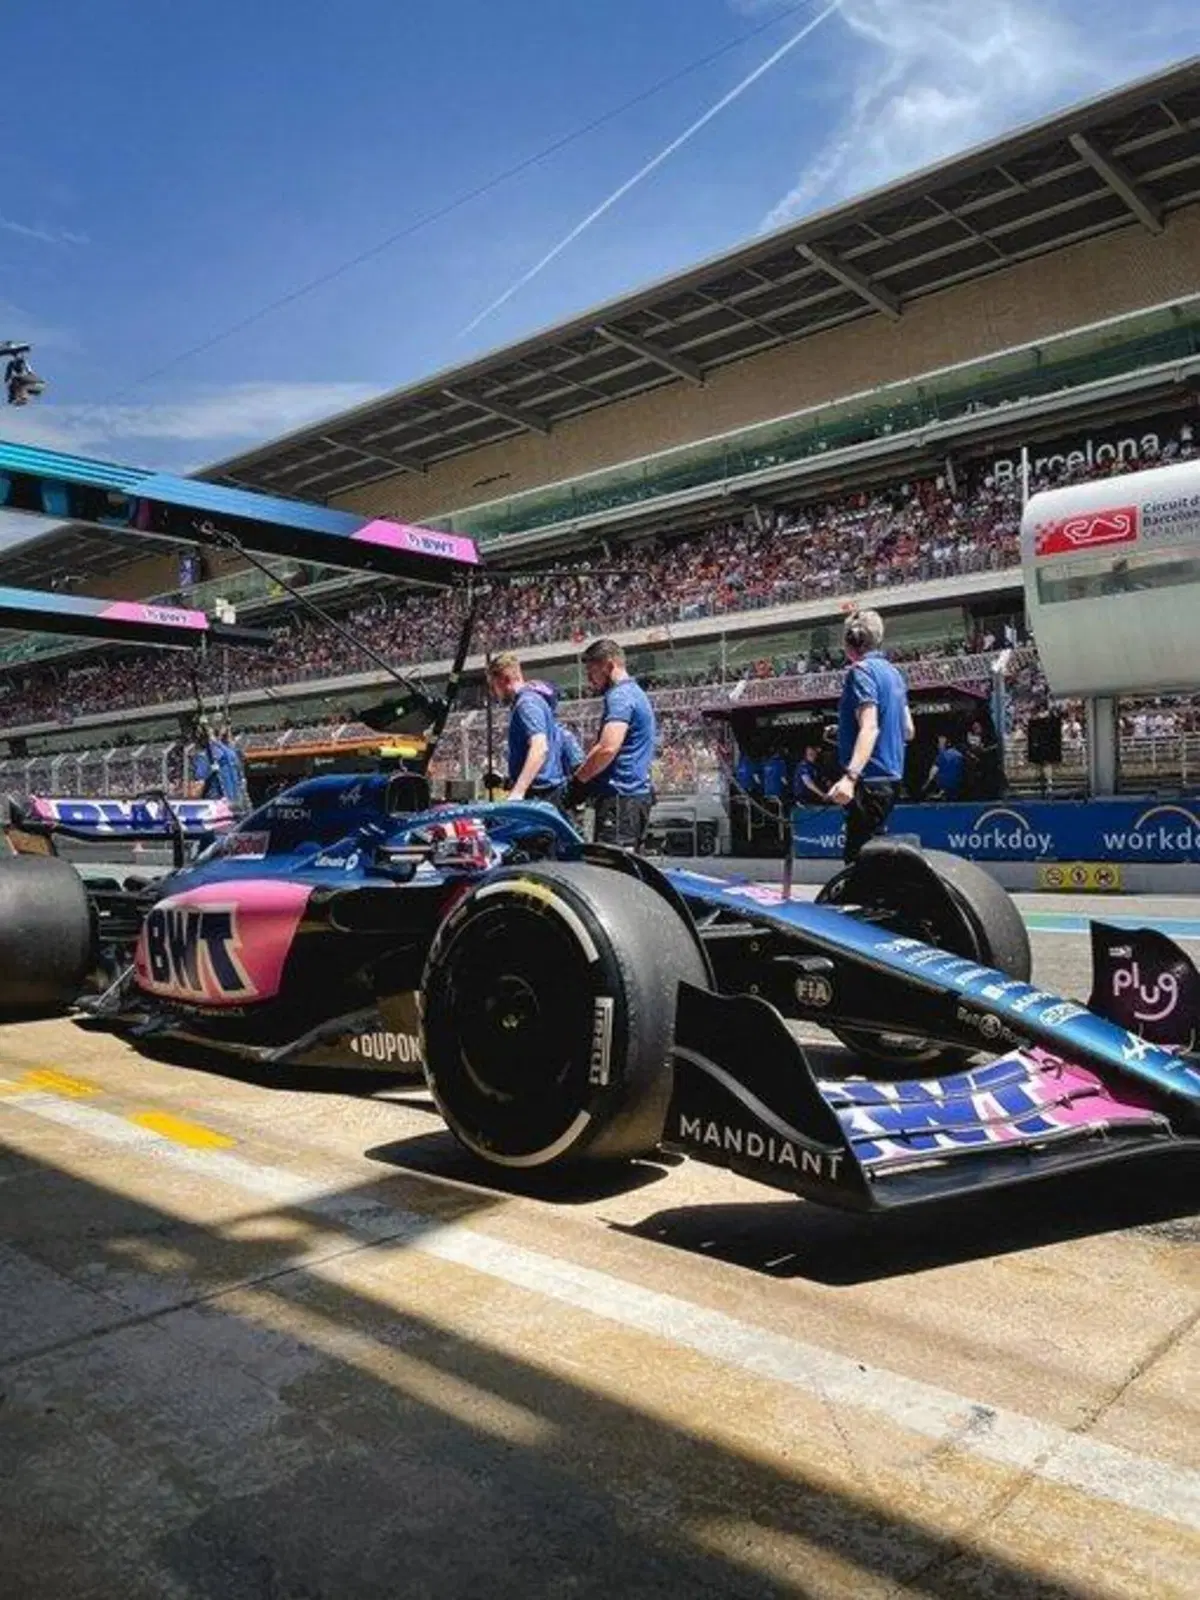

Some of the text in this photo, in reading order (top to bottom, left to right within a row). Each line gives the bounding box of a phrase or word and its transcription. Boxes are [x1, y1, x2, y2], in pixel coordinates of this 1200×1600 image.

[994, 433, 1159, 487] Barcelona
[1142, 497, 1188, 513] Circuit
[146, 904, 248, 993] BWT
[797, 979, 828, 1001] FIA
[1113, 961, 1178, 1021] plug
[361, 1031, 422, 1063] DUPON
[679, 1114, 844, 1181] MANDIANT
